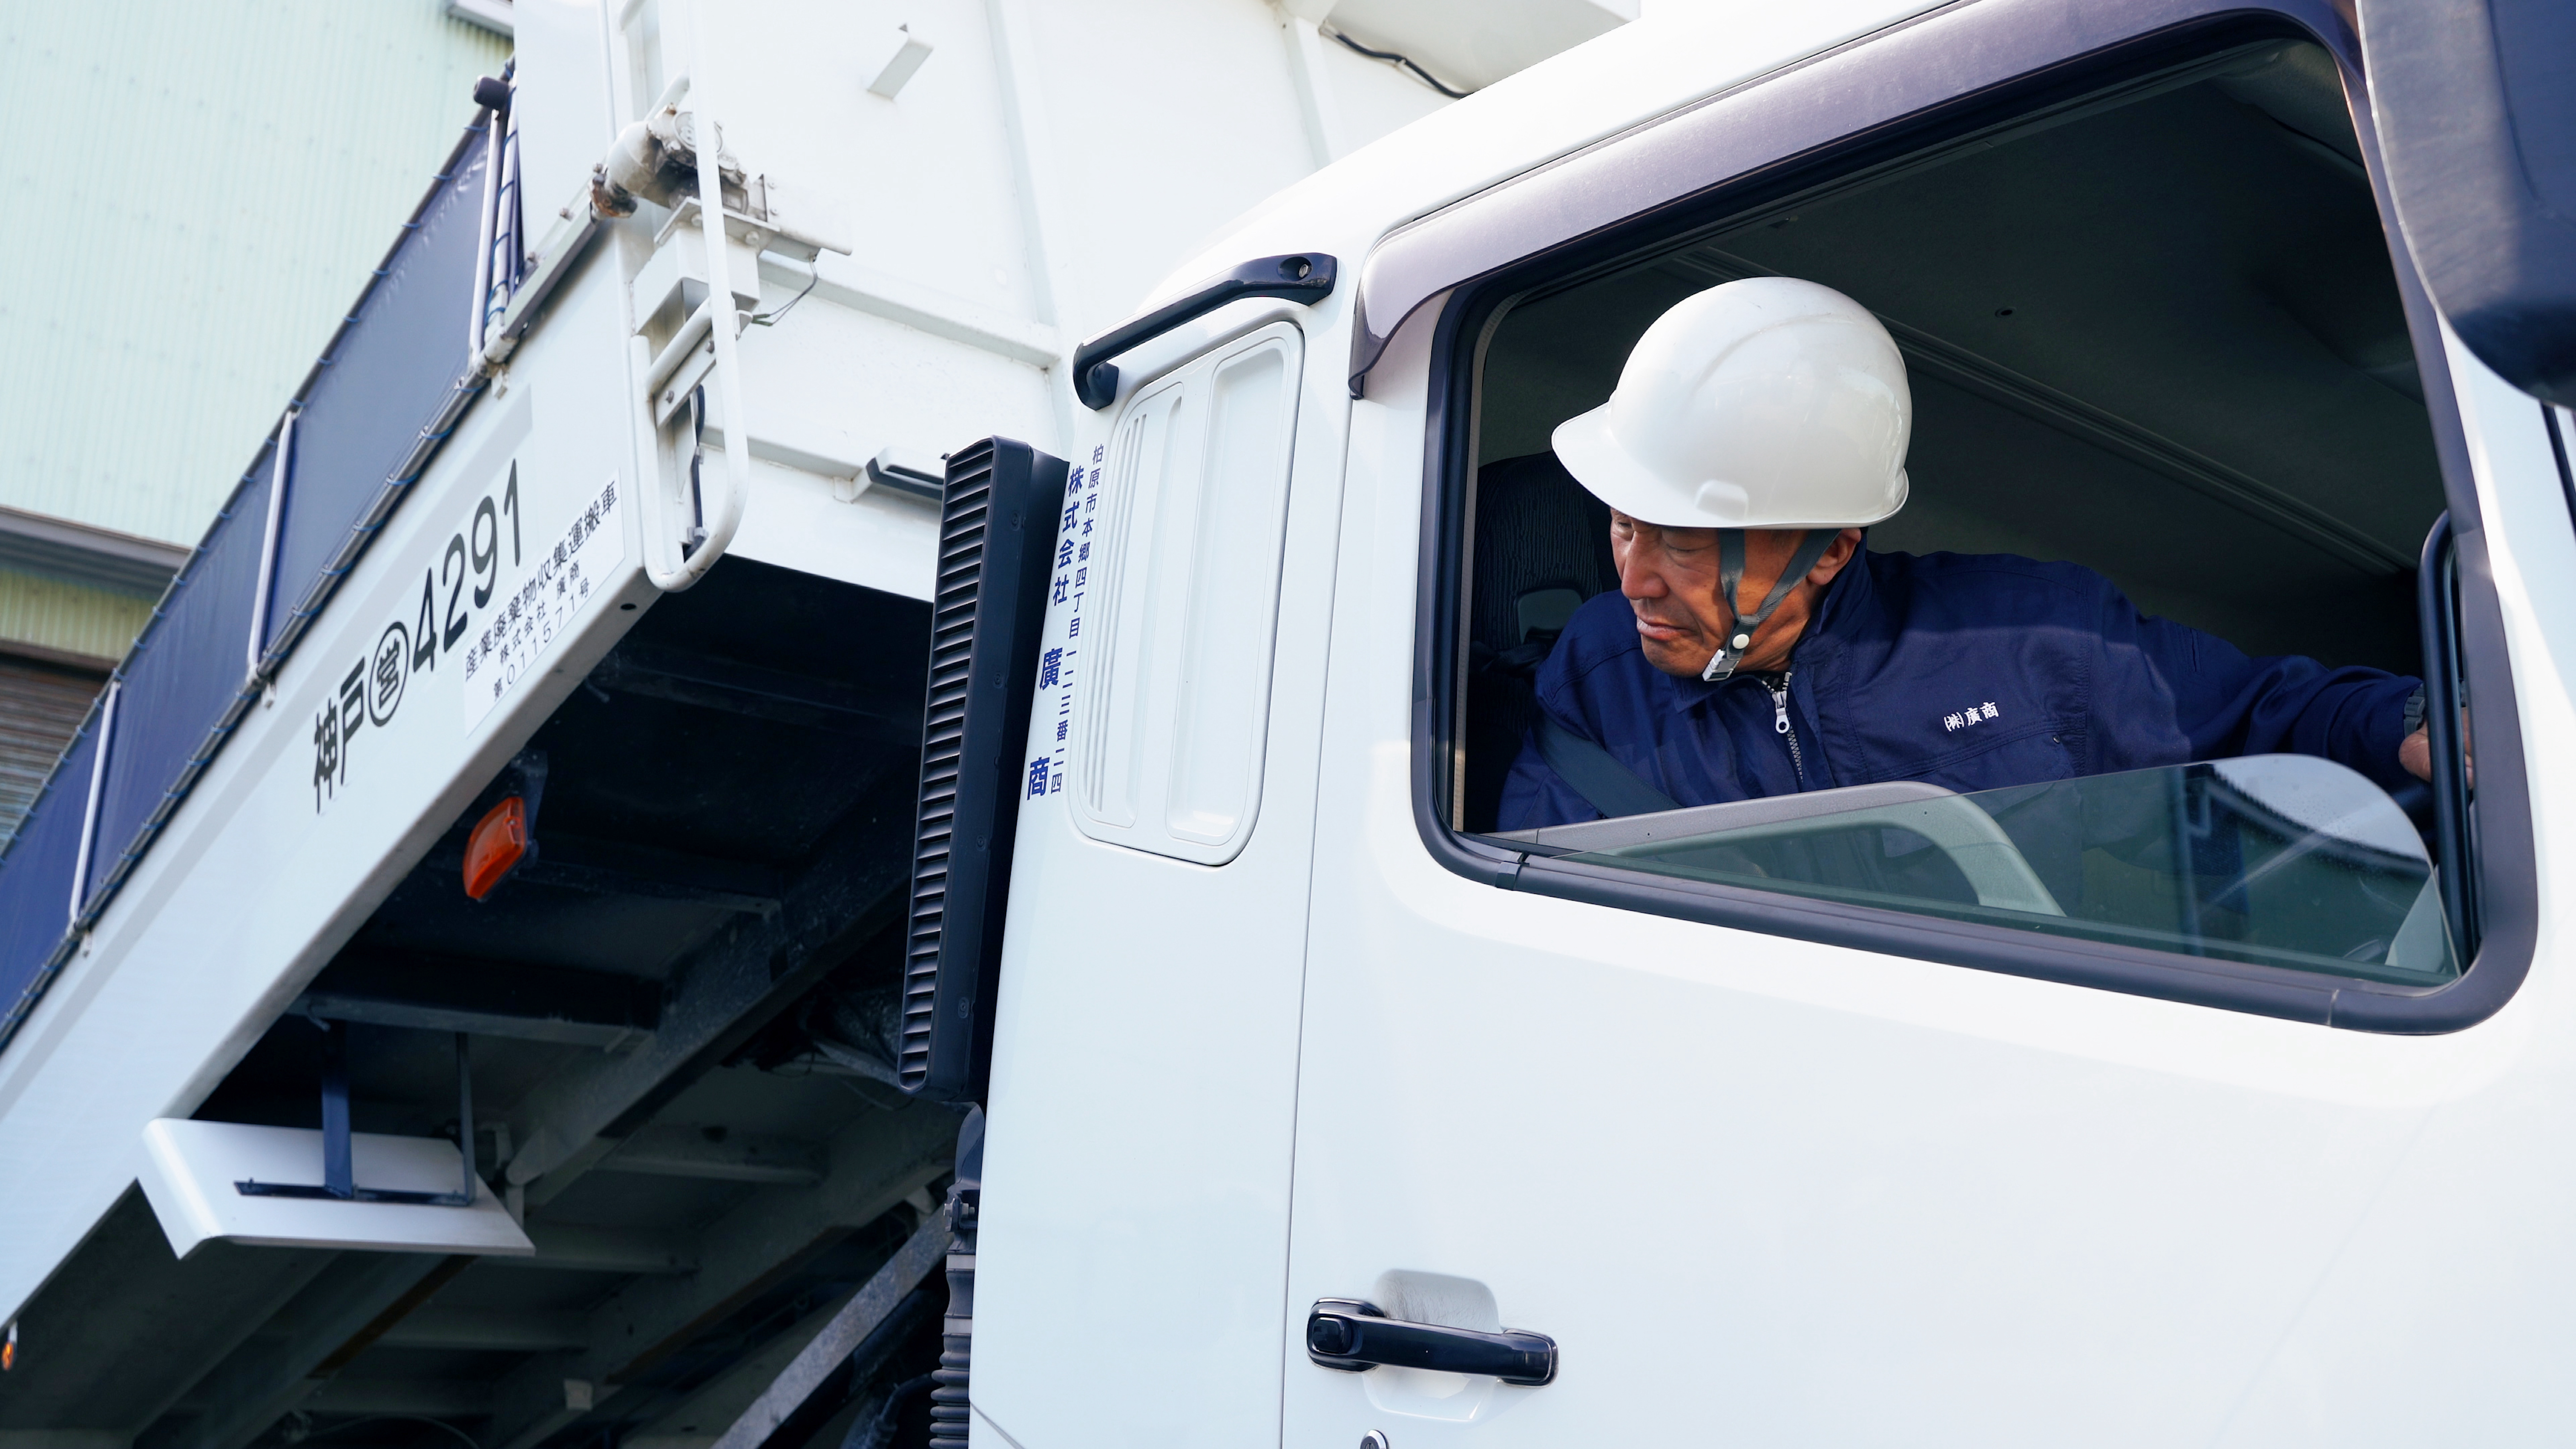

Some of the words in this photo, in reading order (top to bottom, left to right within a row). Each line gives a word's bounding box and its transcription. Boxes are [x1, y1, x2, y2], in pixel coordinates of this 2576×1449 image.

[466, 480, 617, 682] 産業廃棄物収集運搬車
[1053, 465, 1084, 606] 株式会社
[500, 599, 548, 667] 株式会社
